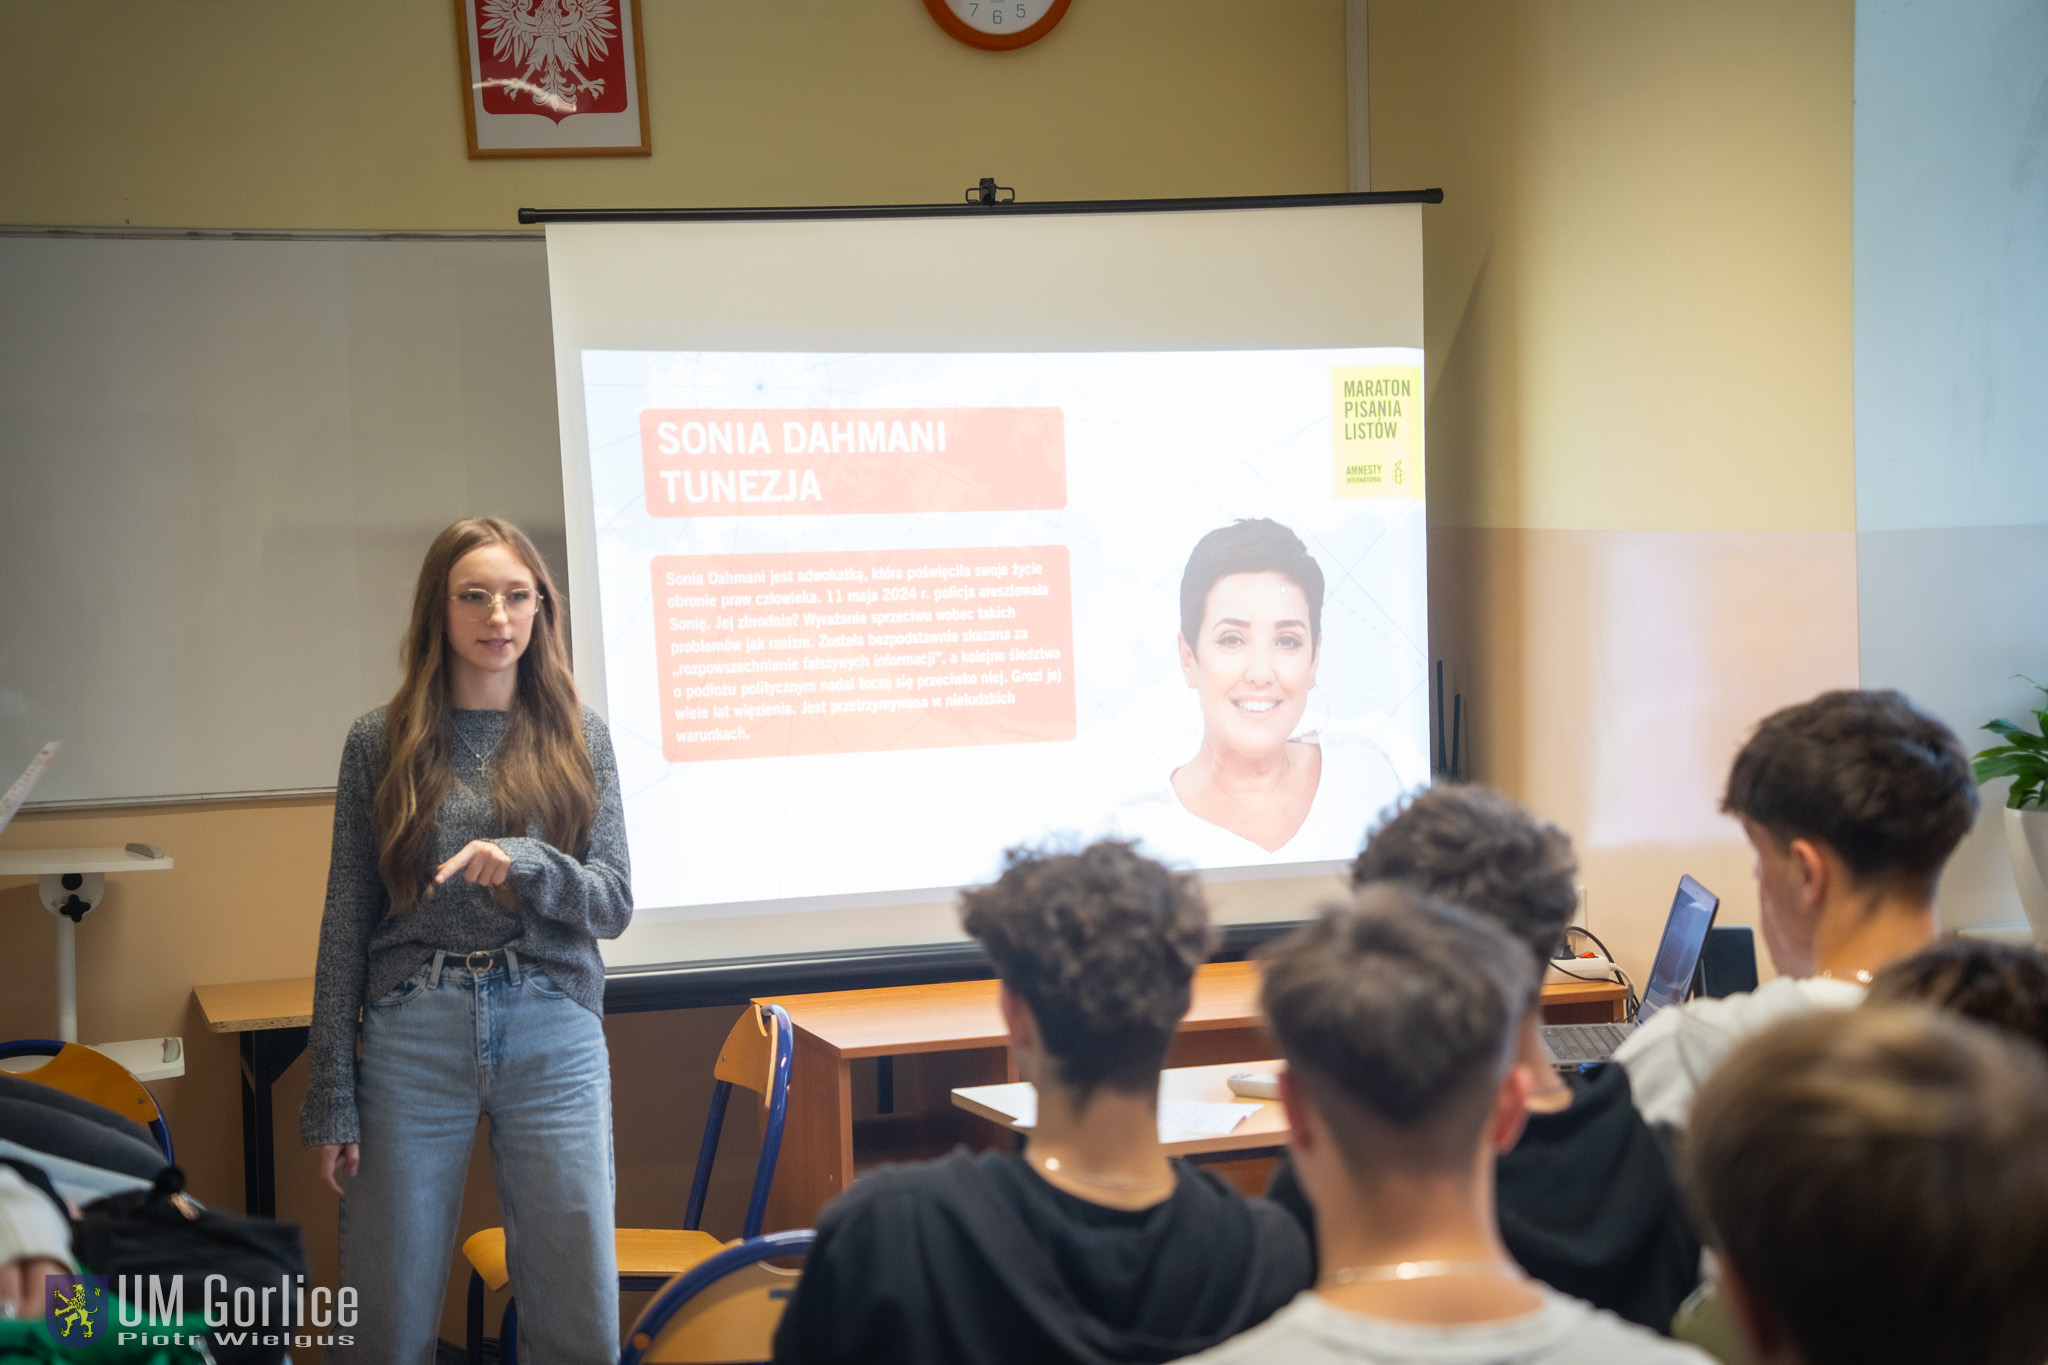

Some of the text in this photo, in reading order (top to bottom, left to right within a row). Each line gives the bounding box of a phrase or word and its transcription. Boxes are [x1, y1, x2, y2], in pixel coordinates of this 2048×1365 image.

[969, 3, 979, 17] 7
[992, 10, 1002, 24] 6
[1016, 4, 1026, 18] 5
[1344, 379, 1411, 397] MARATON
[1345, 400, 1402, 418] PISANIA
[657, 419, 947, 455] SONIA DAHMANI
[1345, 418, 1397, 440] LISTÓW
[1346, 464, 1382, 475] AMNESTY
[659, 469, 822, 503] TUNEZJA
[666, 562, 1043, 586] Sonia Dahmani jest adwokatką, która poświęciła swoje życie
[667, 583, 1049, 609] obronie praw człowieka. 11 maja 2024 r. policja aresztowała
[669, 606, 1016, 633] Sonię. Jej zbrodnia? Wyrażanie sprzeciwu wobec takich
[671, 628, 1028, 656] problemów jak rasizm. Została bezpodstawnie skazana za
[672, 658, 799, 677] „rozpowszechnianie
[803, 654, 869, 671] fałszywych
[950, 653, 958, 664] a
[961, 650, 1005, 665] kolejne
[1009, 647, 1061, 662] śledztwa
[673, 668, 1062, 700] o podłożu politycznym nadal toczą się przeciwko niej. Grozi jej
[674, 691, 1016, 720] wiele lat więzienia. Jest przetrzymywana w nieludzkich
[676, 727, 751, 743] warunkach.
